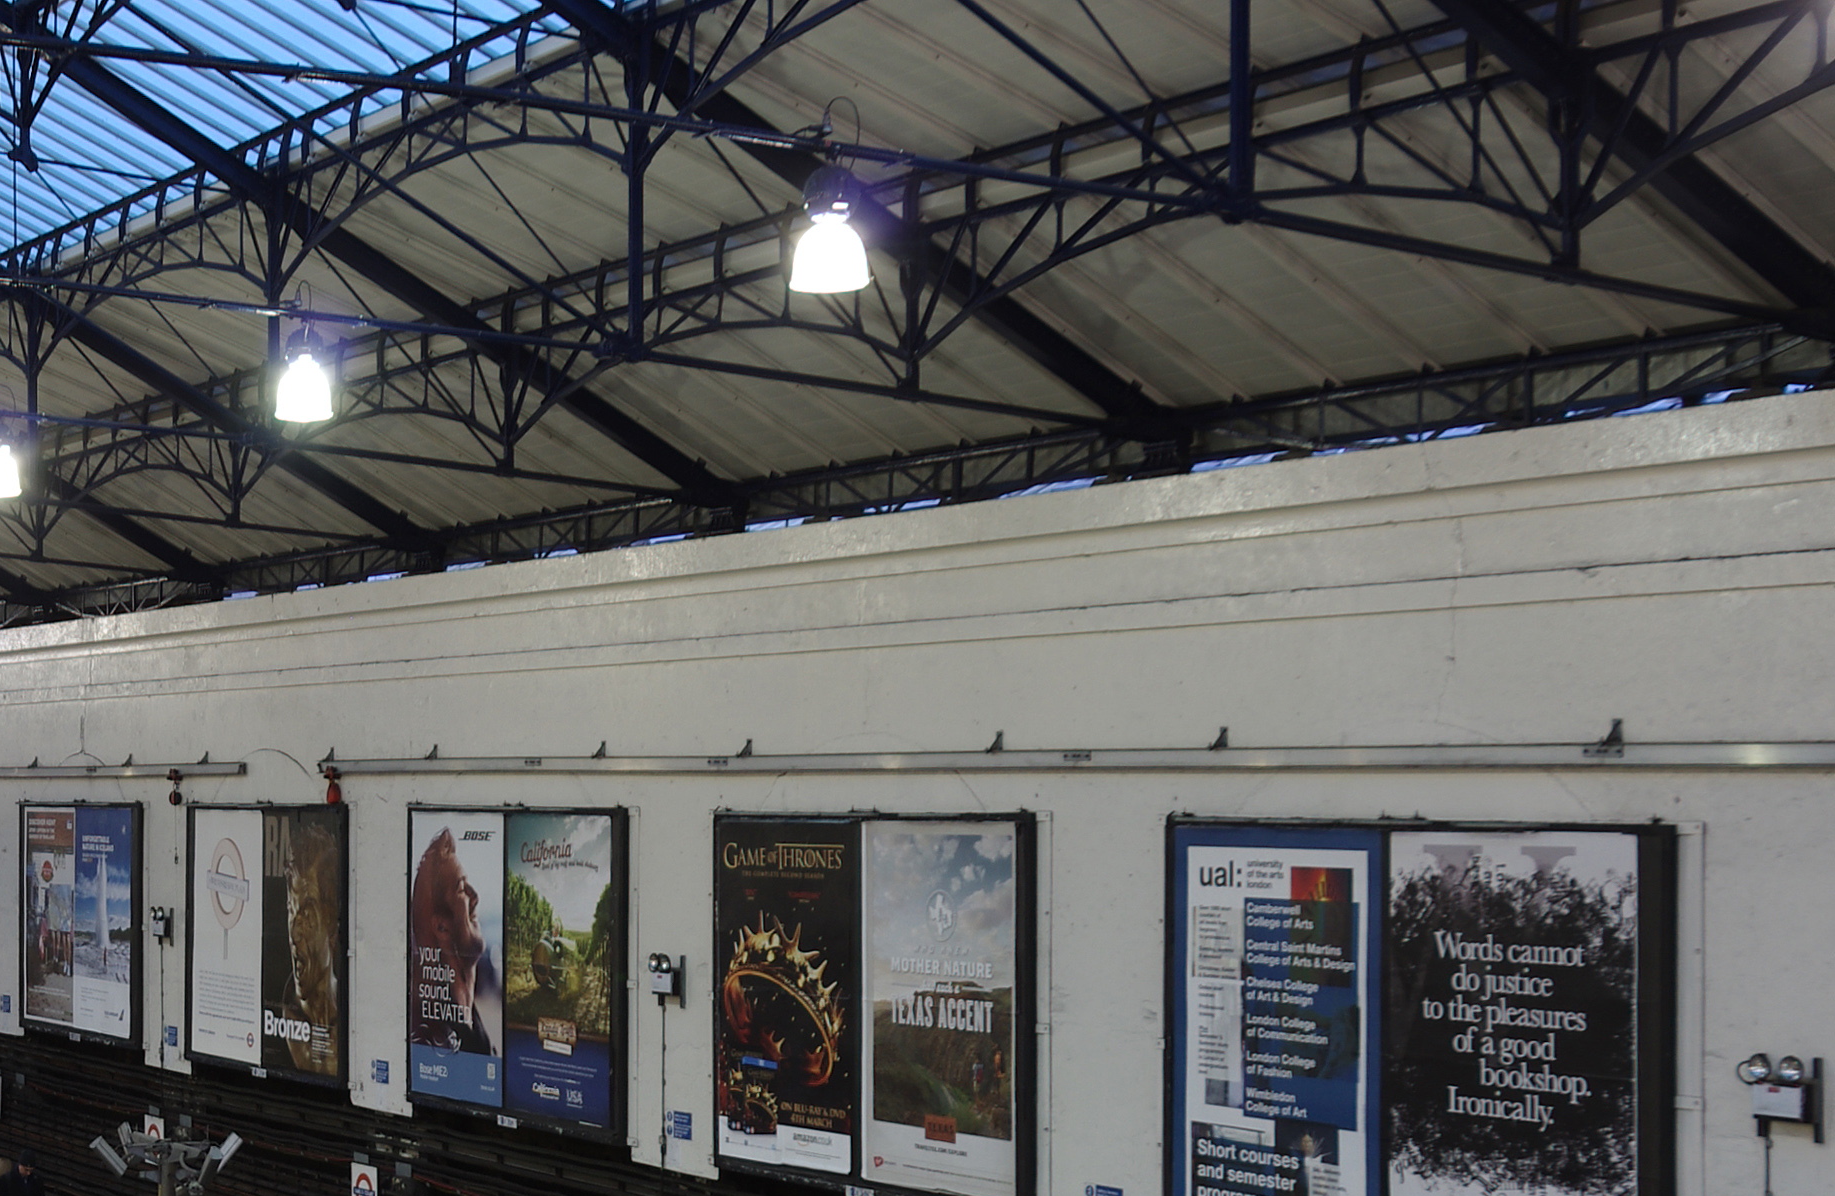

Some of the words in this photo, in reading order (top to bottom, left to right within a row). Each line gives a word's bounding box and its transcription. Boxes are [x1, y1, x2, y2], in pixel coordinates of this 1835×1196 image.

[459, 831, 496, 841] BOSE
[266, 816, 290, 877] RA
[521, 838, 572, 868] California
[724, 842, 766, 869] GAME
[774, 843, 844, 870] THRONES
[1247, 860, 1283, 870] university
[1247, 870, 1256, 878] of
[1256, 870, 1268, 879] the
[1269, 871, 1284, 879] arts
[1247, 880, 1272, 888] london
[1246, 902, 1301, 916] Camberwell
[1246, 916, 1280, 930] College
[1282, 917, 1292, 928] of
[1294, 918, 1314, 930] Arts
[420, 946, 442, 965] your
[1246, 939, 1279, 951] Central
[1282, 942, 1304, 953] Saint
[1306, 943, 1342, 956] Martins
[1434, 929, 1503, 963] Words
[1508, 943, 1586, 966] cannot
[891, 956, 940, 976] MOTHER
[944, 960, 993, 979] NATURE
[1246, 952, 1280, 966] College
[1282, 954, 1292, 966] of
[1292, 956, 1312, 967] Arts
[1314, 958, 1321, 968] &
[1324, 959, 1356, 973] Design
[422, 964, 456, 983] mobile
[1452, 964, 1480, 992] do
[1480, 965, 1554, 1000] justice
[419, 983, 452, 1001] sound.
[1246, 976, 1282, 990] Chelsea
[1284, 979, 1320, 994] College
[1246, 990, 1256, 1000] of
[1257, 991, 1272, 1002] Art
[1273, 992, 1280, 1002] &
[1282, 993, 1314, 1008] Design
[891, 995, 934, 1028] TEXAS
[938, 997, 994, 1033] ACCENT
[1246, 1014, 1280, 1026] London
[1282, 1016, 1316, 1030] College
[1422, 998, 1444, 1019] to
[1448, 994, 1482, 1023] the
[1486, 998, 1586, 1032] pleasures
[264, 1010, 311, 1042] Bronze
[1246, 1028, 1256, 1038] of
[1258, 1029, 1328, 1045] Communication
[1453, 1026, 1479, 1053] of
[1481, 1036, 1496, 1055] a
[1500, 1033, 1556, 1065] good
[1246, 1050, 1280, 1064] London
[1282, 1054, 1316, 1069] College
[1246, 1064, 1256, 1075] of
[1258, 1066, 1292, 1079] Fashion
[1479, 1058, 1592, 1105] bookshop.
[1246, 1087, 1296, 1103] Wimbledon
[1246, 1102, 1280, 1116] College
[1282, 1106, 1291, 1116] of
[1292, 1107, 1308, 1118] Art
[1447, 1085, 1554, 1132] Ironically.
[1197, 1138, 1237, 1160] Short
[1240, 1148, 1300, 1170] courses
[1197, 1163, 1224, 1180] and
[1227, 1169, 1296, 1192] semester
